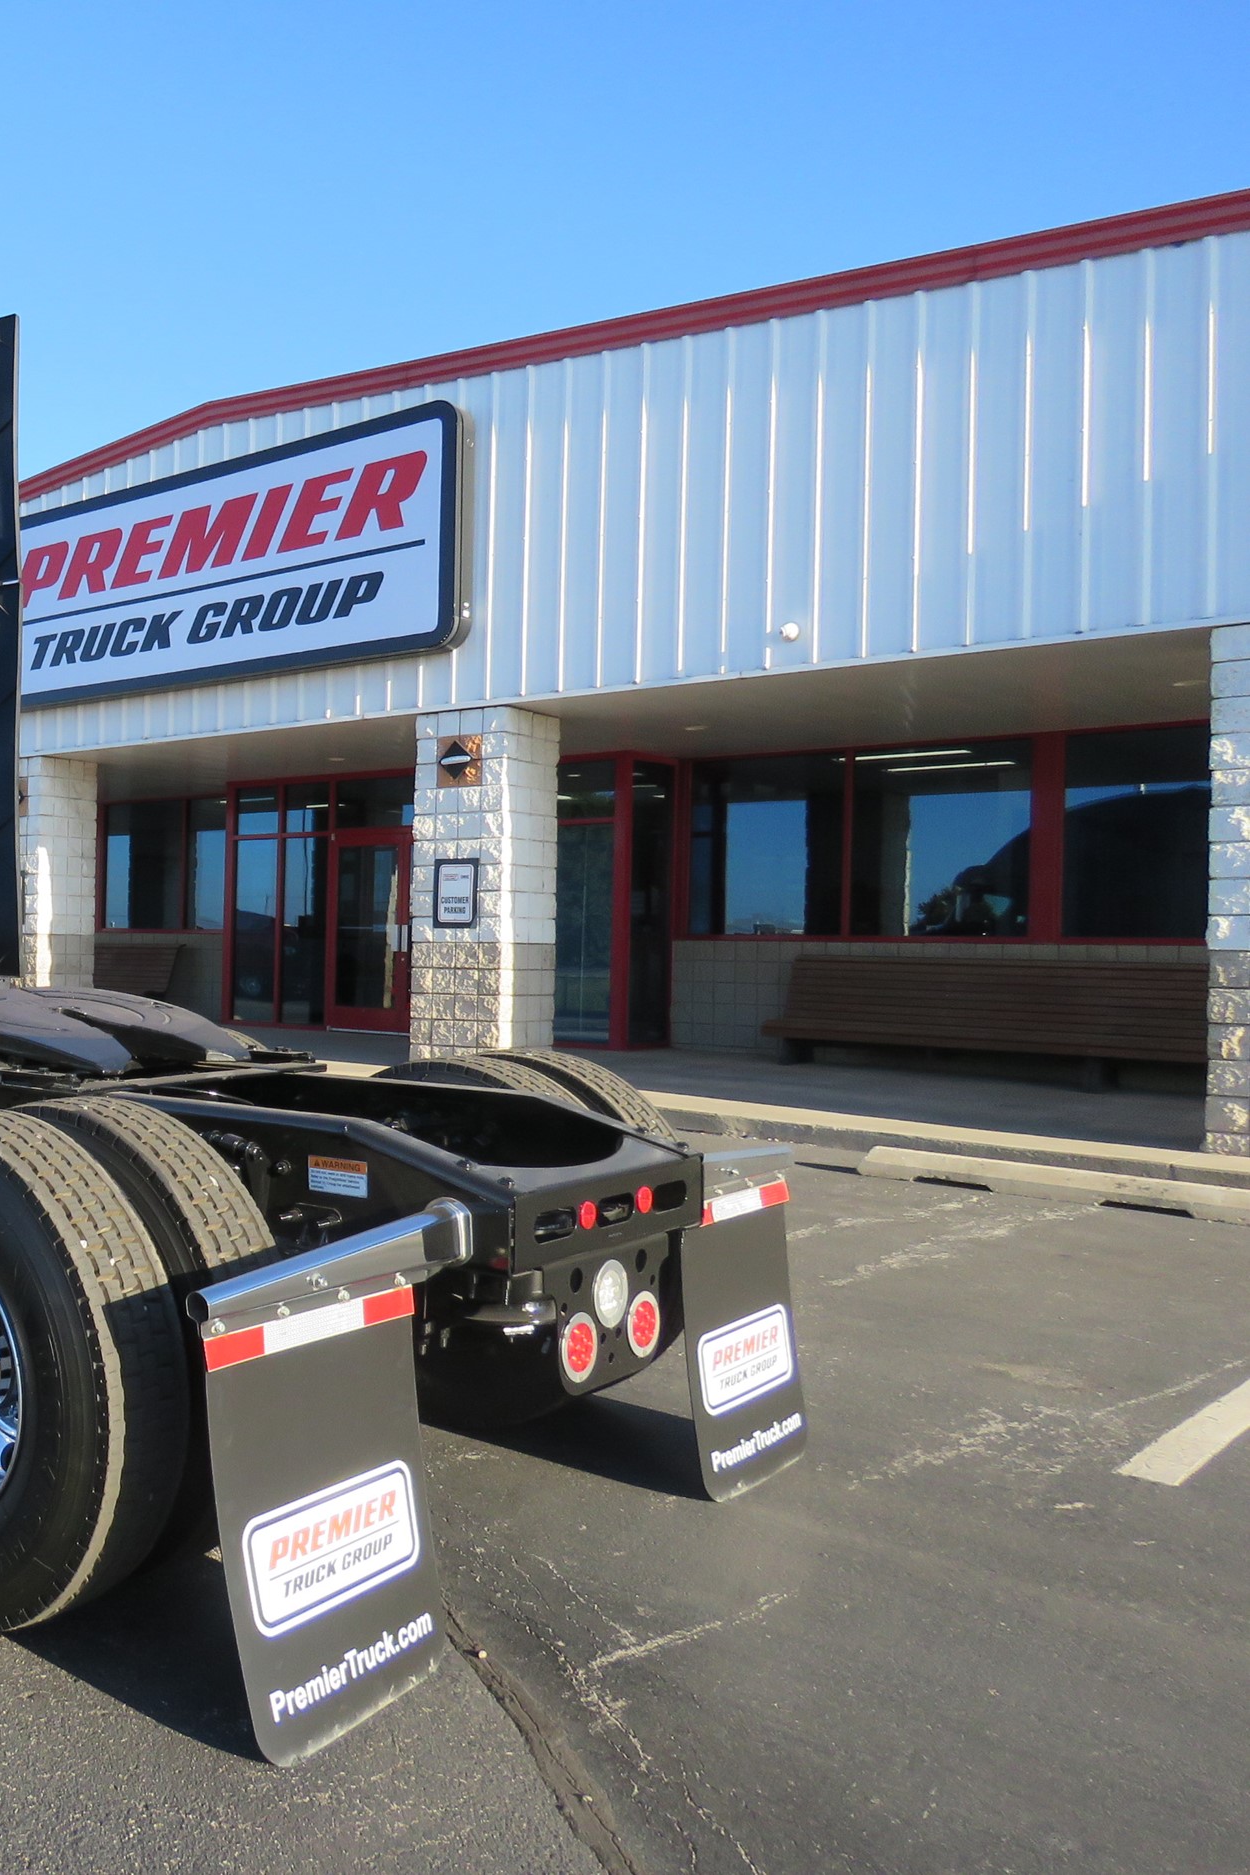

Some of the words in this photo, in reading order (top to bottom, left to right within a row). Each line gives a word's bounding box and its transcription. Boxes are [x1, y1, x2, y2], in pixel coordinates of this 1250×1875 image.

[21, 450, 428, 608] PREMIER
[30, 609, 184, 671] TRUCK
[186, 570, 385, 645] GROUP
[440, 896, 469, 904] CUSTOMER
[443, 906, 466, 914] PARKING
[321, 1159, 361, 1172] WARNING
[712, 1325, 779, 1371] PREMIER
[719, 1367, 749, 1390] TRUCK
[750, 1355, 778, 1377] GROUP
[711, 1412, 802, 1473] PremierTruck.com
[269, 1489, 397, 1570] PREMIER
[283, 1559, 337, 1598] TRUCK
[342, 1533, 393, 1570] GROUP
[268, 1611, 434, 1723] PremierTruck.com
